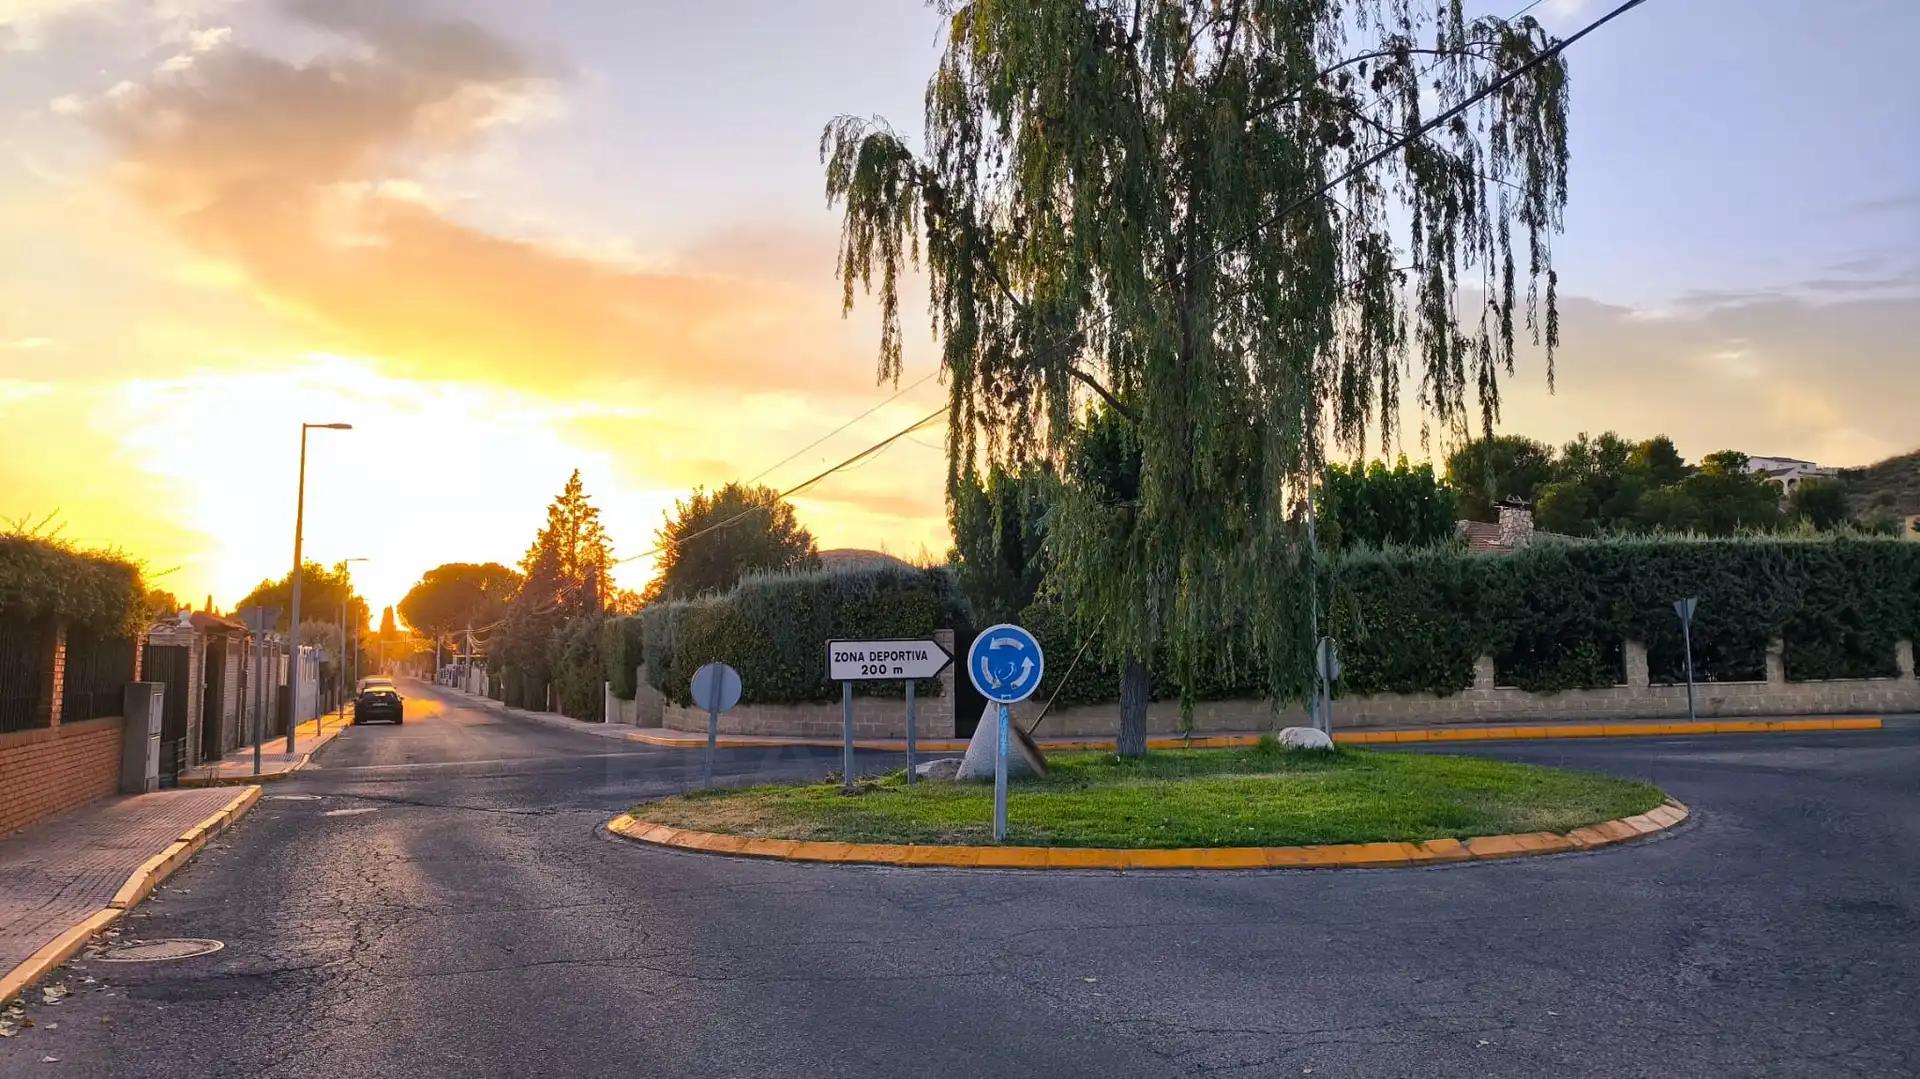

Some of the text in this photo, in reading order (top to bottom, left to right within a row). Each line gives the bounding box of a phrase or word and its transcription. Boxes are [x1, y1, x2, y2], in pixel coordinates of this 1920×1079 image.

[834, 650, 928, 662] ZONA DEPORTIVA
[861, 664, 903, 675] 200 m
